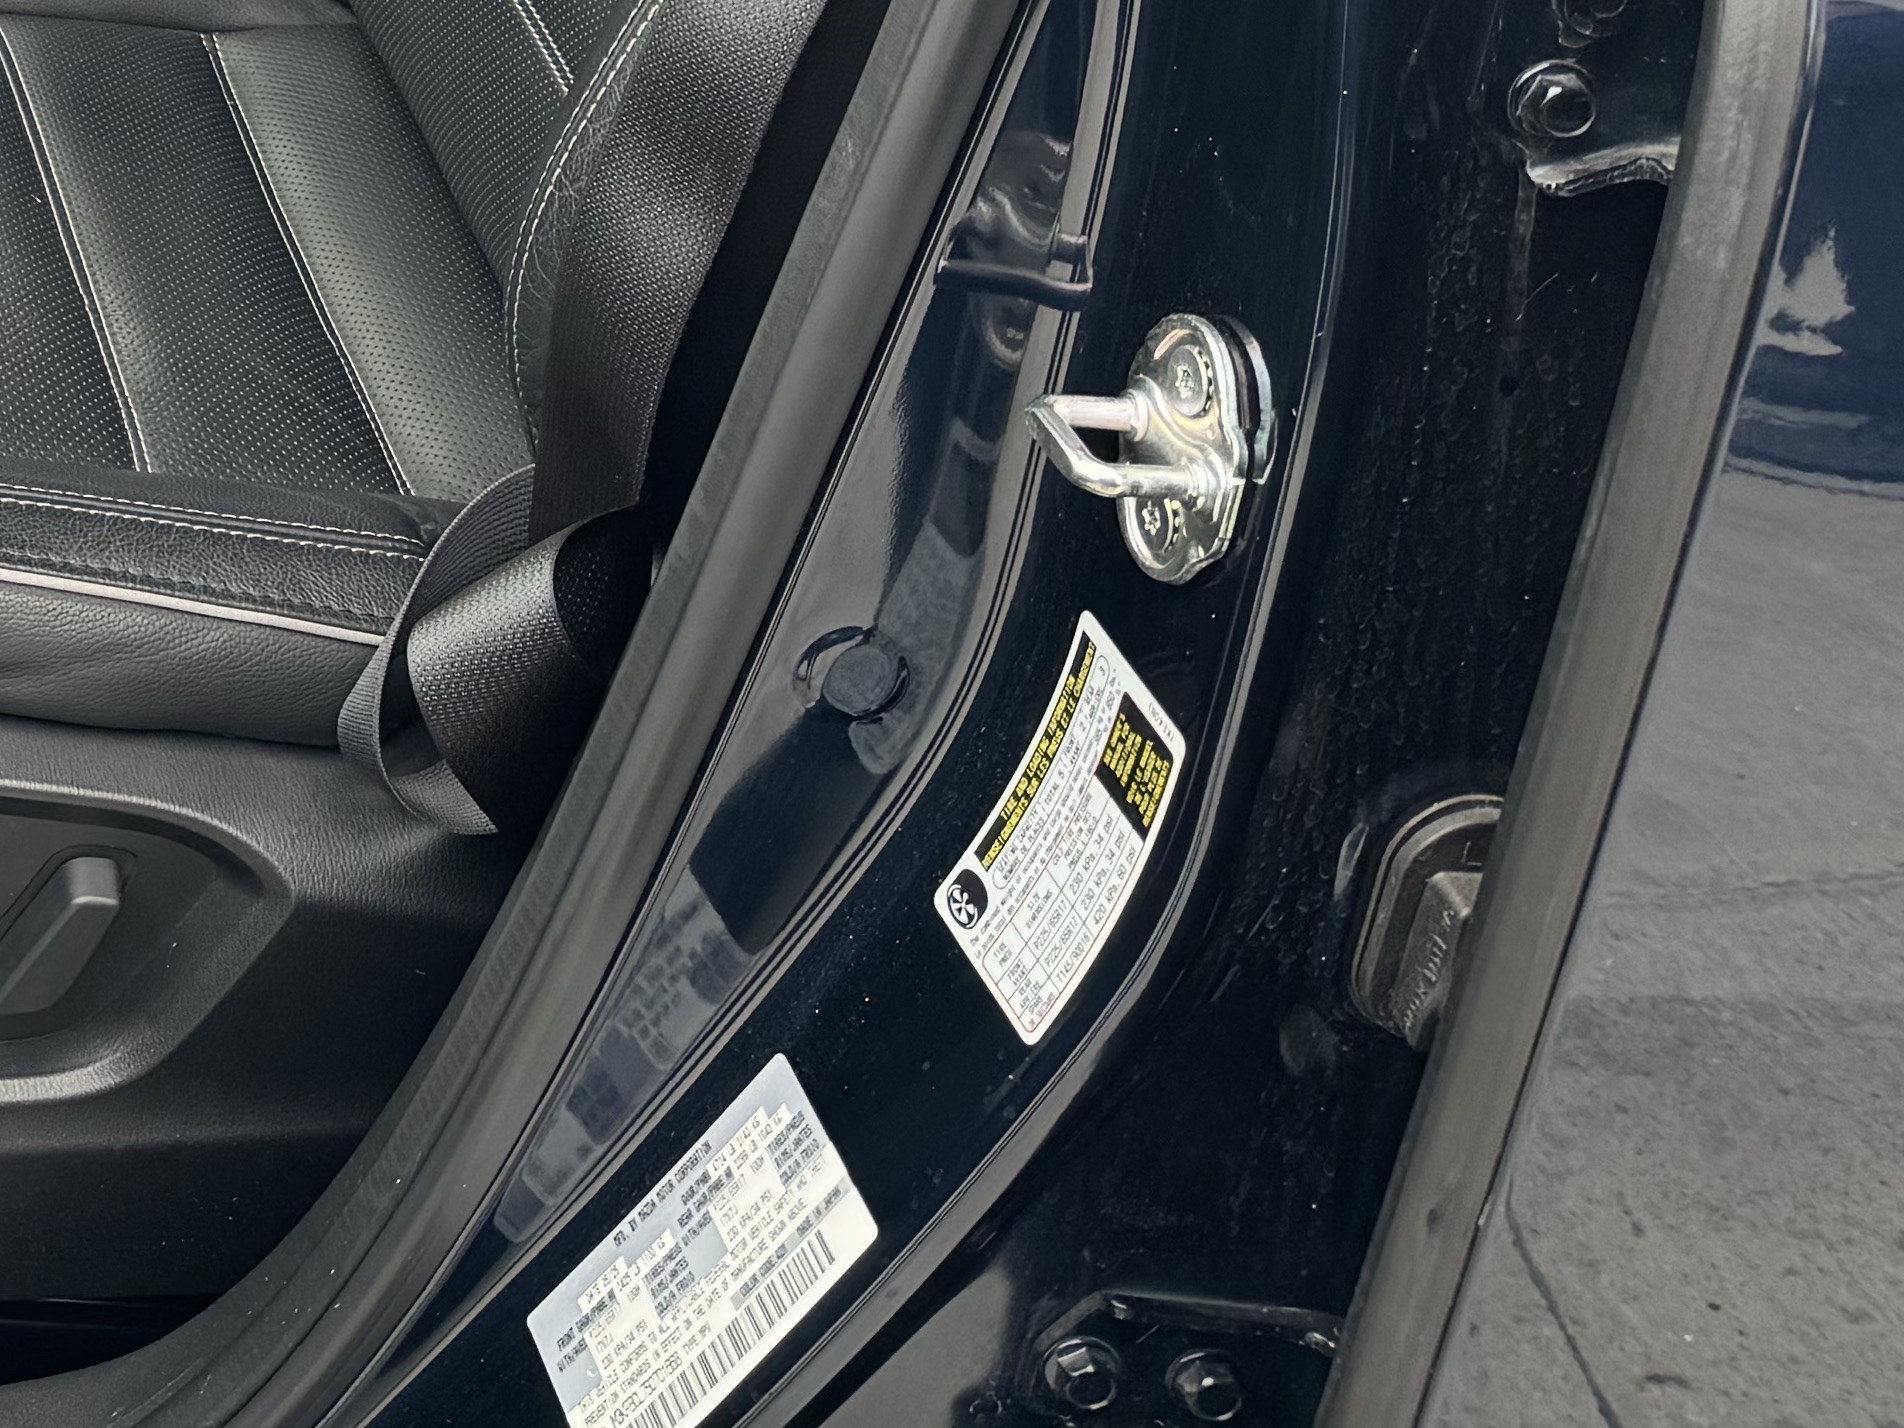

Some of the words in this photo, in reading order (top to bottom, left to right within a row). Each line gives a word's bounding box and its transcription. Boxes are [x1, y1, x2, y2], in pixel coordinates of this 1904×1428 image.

[1043, 779, 1058, 806] TOTAL
[1057, 767, 1065, 780] 5
[1068, 870, 1084, 896] 230
[1094, 832, 1103, 848] 34
[1101, 812, 1113, 834] psi
[1080, 886, 1096, 911] 230
[1105, 848, 1115, 865] 34
[1113, 827, 1125, 850] psi
[1091, 902, 1107, 927] 420
[1116, 861, 1127, 881] 60
[1124, 843, 1136, 866] psi
